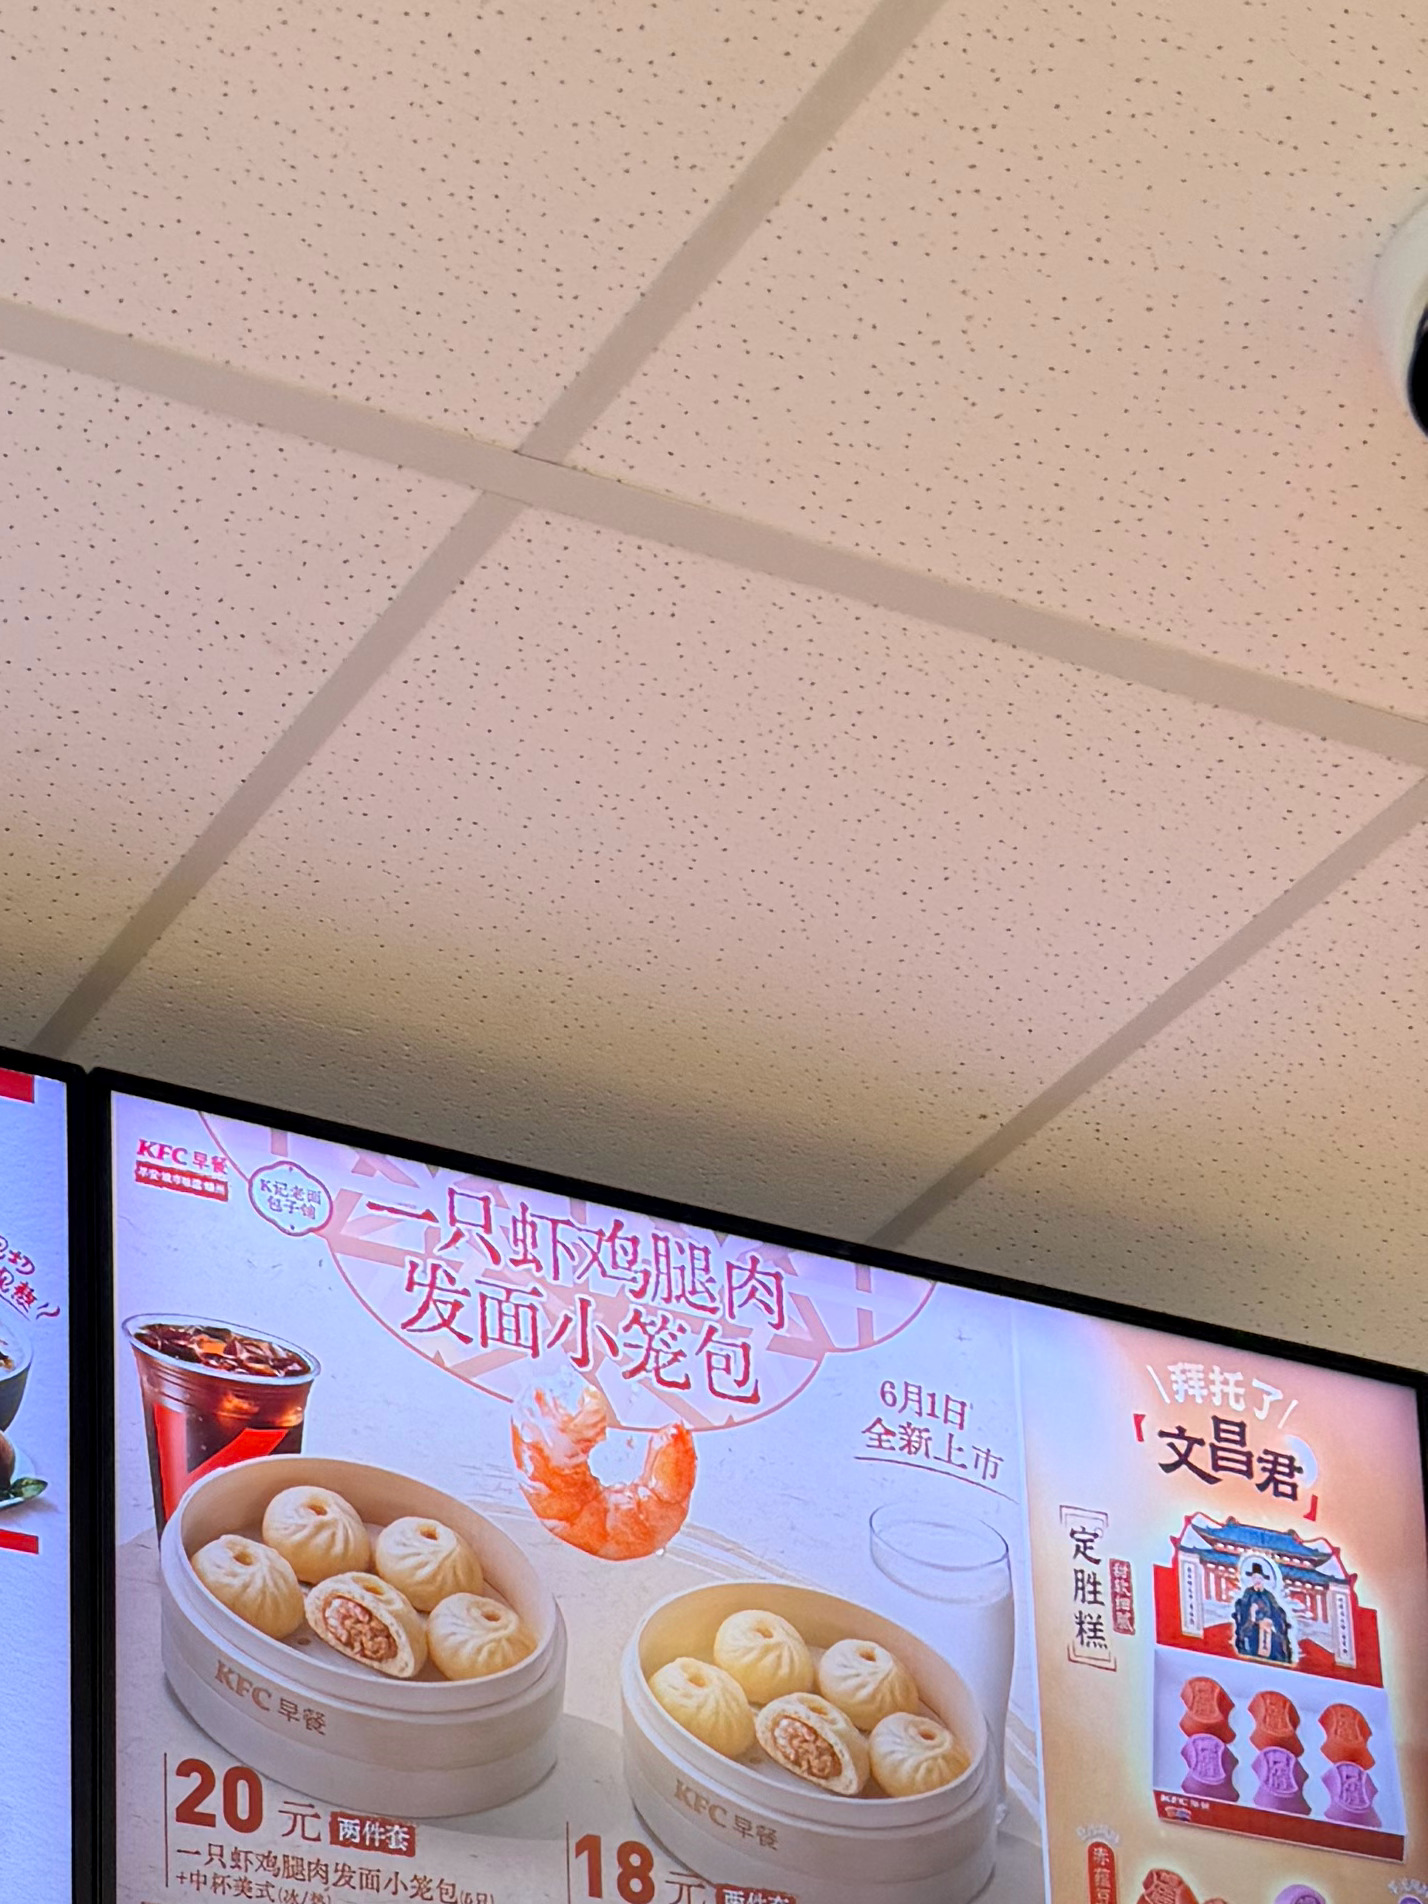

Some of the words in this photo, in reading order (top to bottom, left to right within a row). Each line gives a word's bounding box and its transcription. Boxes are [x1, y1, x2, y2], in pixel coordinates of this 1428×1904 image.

[137, 1139, 188, 1167] KFC
[367, 1187, 786, 1331] 一只虾鸡腿肉
[402, 1258, 761, 1406] 发面小笼包
[881, 1379, 970, 1431] 6月1日
[1168, 1362, 1284, 1420] 拜托了
[860, 1418, 1005, 1483] 全新上市
[1158, 1415, 1303, 1501] 文昌君
[1069, 1525, 1109, 1650] 定胜糕
[214, 1659, 274, 1712] KFC
[277, 1698, 328, 1737] 早餐
[336, 1817, 410, 1851] 两件套
[674, 1780, 728, 1829] KFC
[732, 1815, 779, 1852] 早餐
